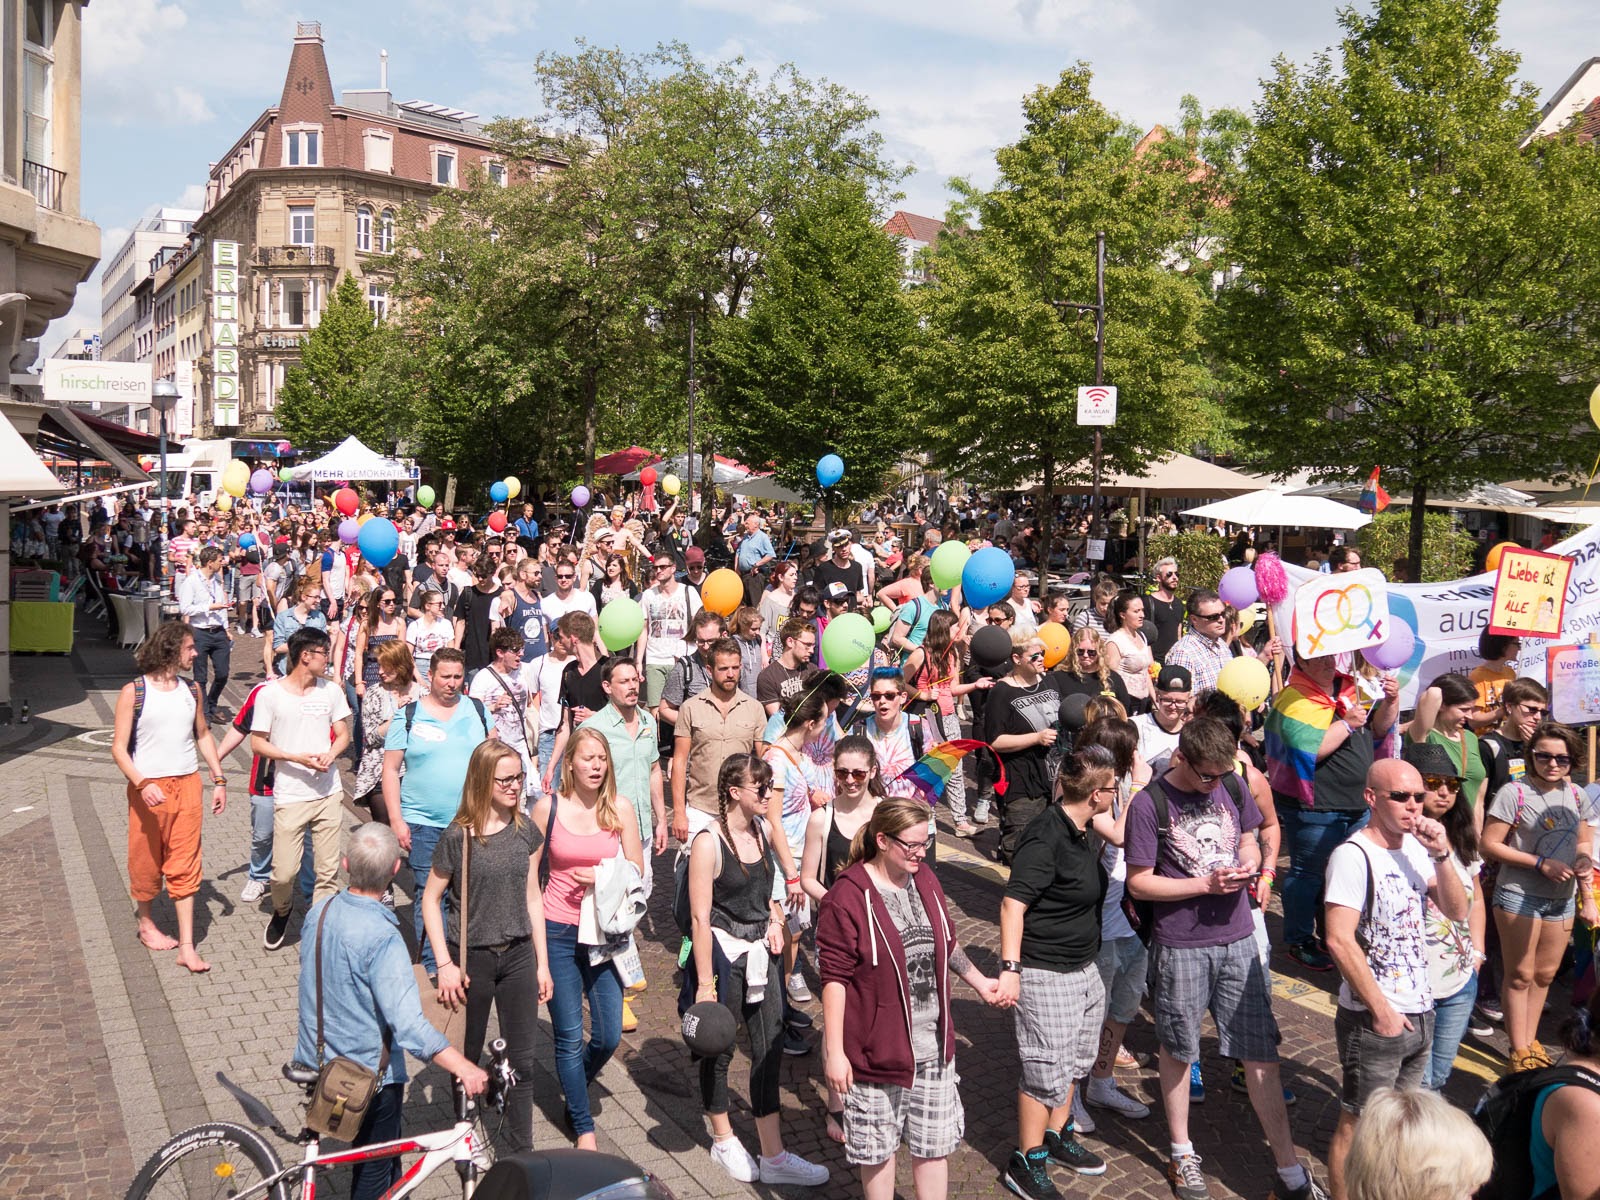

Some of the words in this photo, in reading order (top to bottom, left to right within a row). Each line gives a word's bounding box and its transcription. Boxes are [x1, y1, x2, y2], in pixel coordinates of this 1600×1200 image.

[217, 243, 236, 426] ERHARDT
[60, 374, 146, 392] hirschreisen
[314, 469, 344, 478] MEHR
[346, 469, 406, 478] DEMOKRATIE
[1508, 560, 1539, 583] Liebe
[1543, 565, 1556, 586] ist
[1504, 600, 1530, 614] ALLE
[1448, 647, 1468, 661] im
[688, 1015, 700, 1039] PRIDE
[161, 1130, 225, 1160] SCHWALBE
